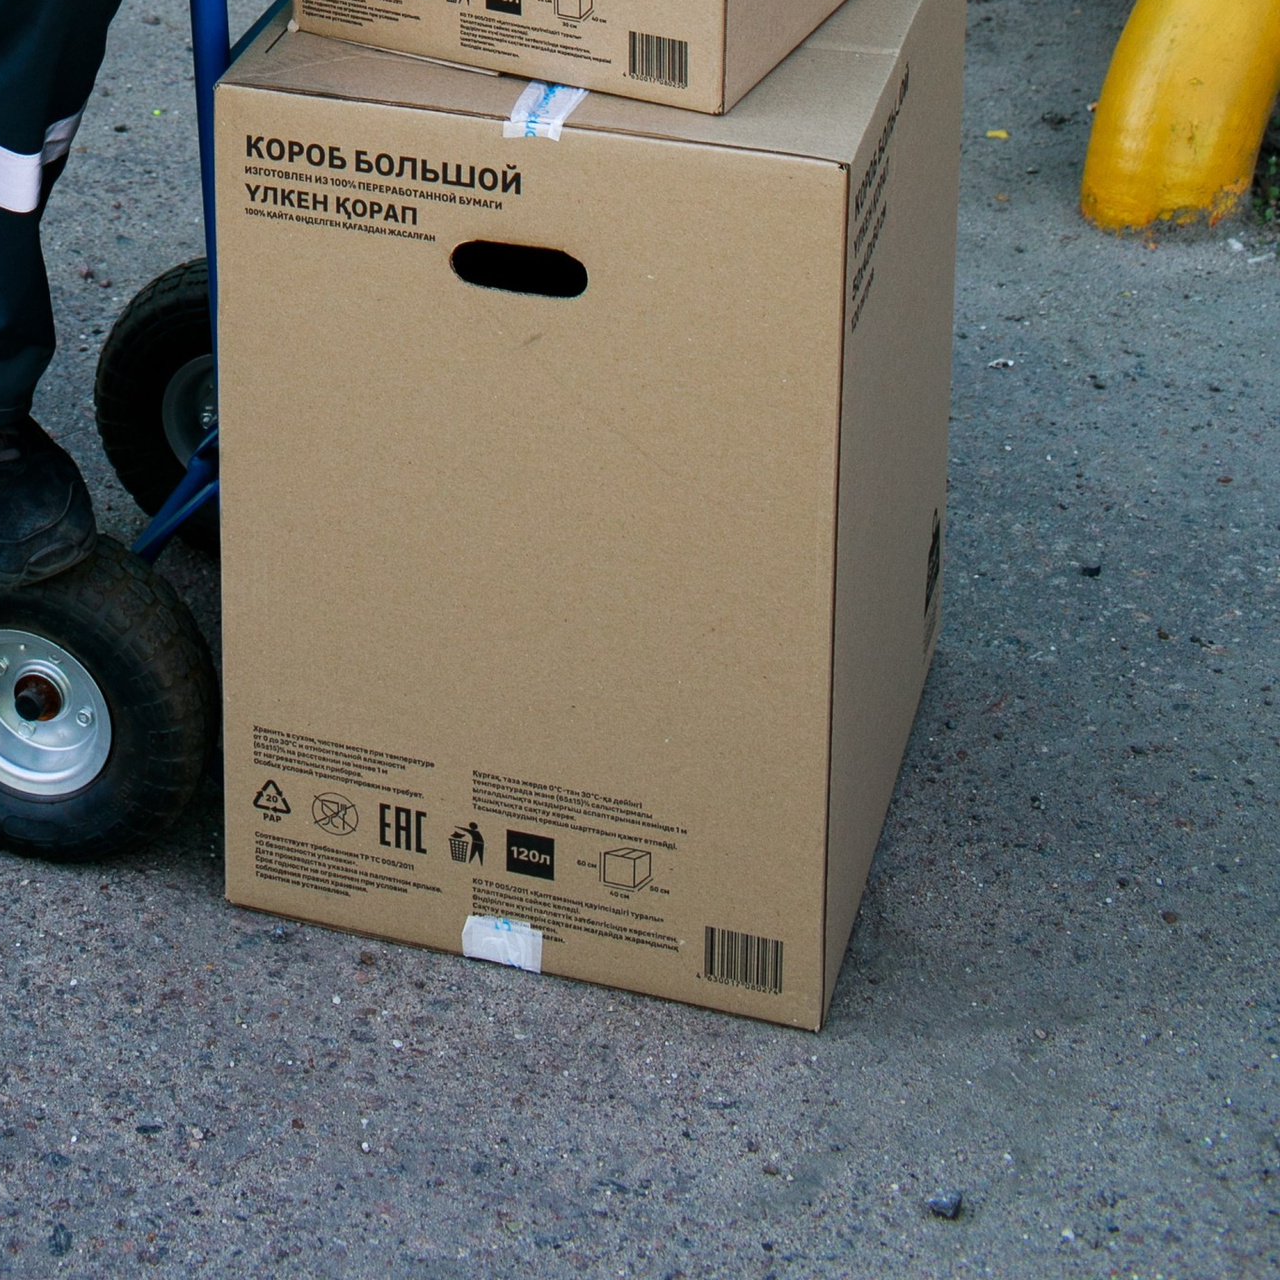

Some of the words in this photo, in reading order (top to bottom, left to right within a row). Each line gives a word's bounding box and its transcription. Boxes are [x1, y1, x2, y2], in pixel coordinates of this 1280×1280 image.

[246, 135, 346, 171] КОРОБ
[354, 150, 521, 194] БОЛЬШОЙ
[244, 166, 312, 183] ИЗГОТОВЛЕН
[314, 175, 328, 186] ИЗ
[330, 177, 356, 190] 100%
[357, 181, 456, 203] ПЕРЕРАБОТАННОЙ
[458, 195, 502, 210] БУМАГИ
[244, 208, 265, 217] 100%
[266, 211, 294, 222] ҚАЙТА
[245, 183, 328, 213] ҮЛКЕН
[335, 196, 417, 225] ҚОРАП
[252, 725, 285, 737] Хранить
[316, 739, 344, 749] чистом
[384, 753, 434, 767] температуре
[281, 765, 313, 776] условий
[392, 787, 424, 798] требует.
[266, 794, 278, 803] 20
[263, 813, 282, 823] PAP
[254, 831, 308, 848] Соответствует
[359, 853, 369, 861] ТР
[370, 855, 380, 863] ТС
[381, 857, 414, 870] 005/2011
[254, 847, 273, 857] Дата
[274, 853, 326, 868] производства
[327, 864, 357, 875] указана
[264, 842, 316, 857] безопасности
[510, 846, 551, 865] 120л
[255, 855, 273, 865] Срок
[319, 870, 359, 883] ограничен
[375, 882, 407, 893] условии
[255, 871, 290, 884] Гарантия
[301, 874, 329, 884] правил
